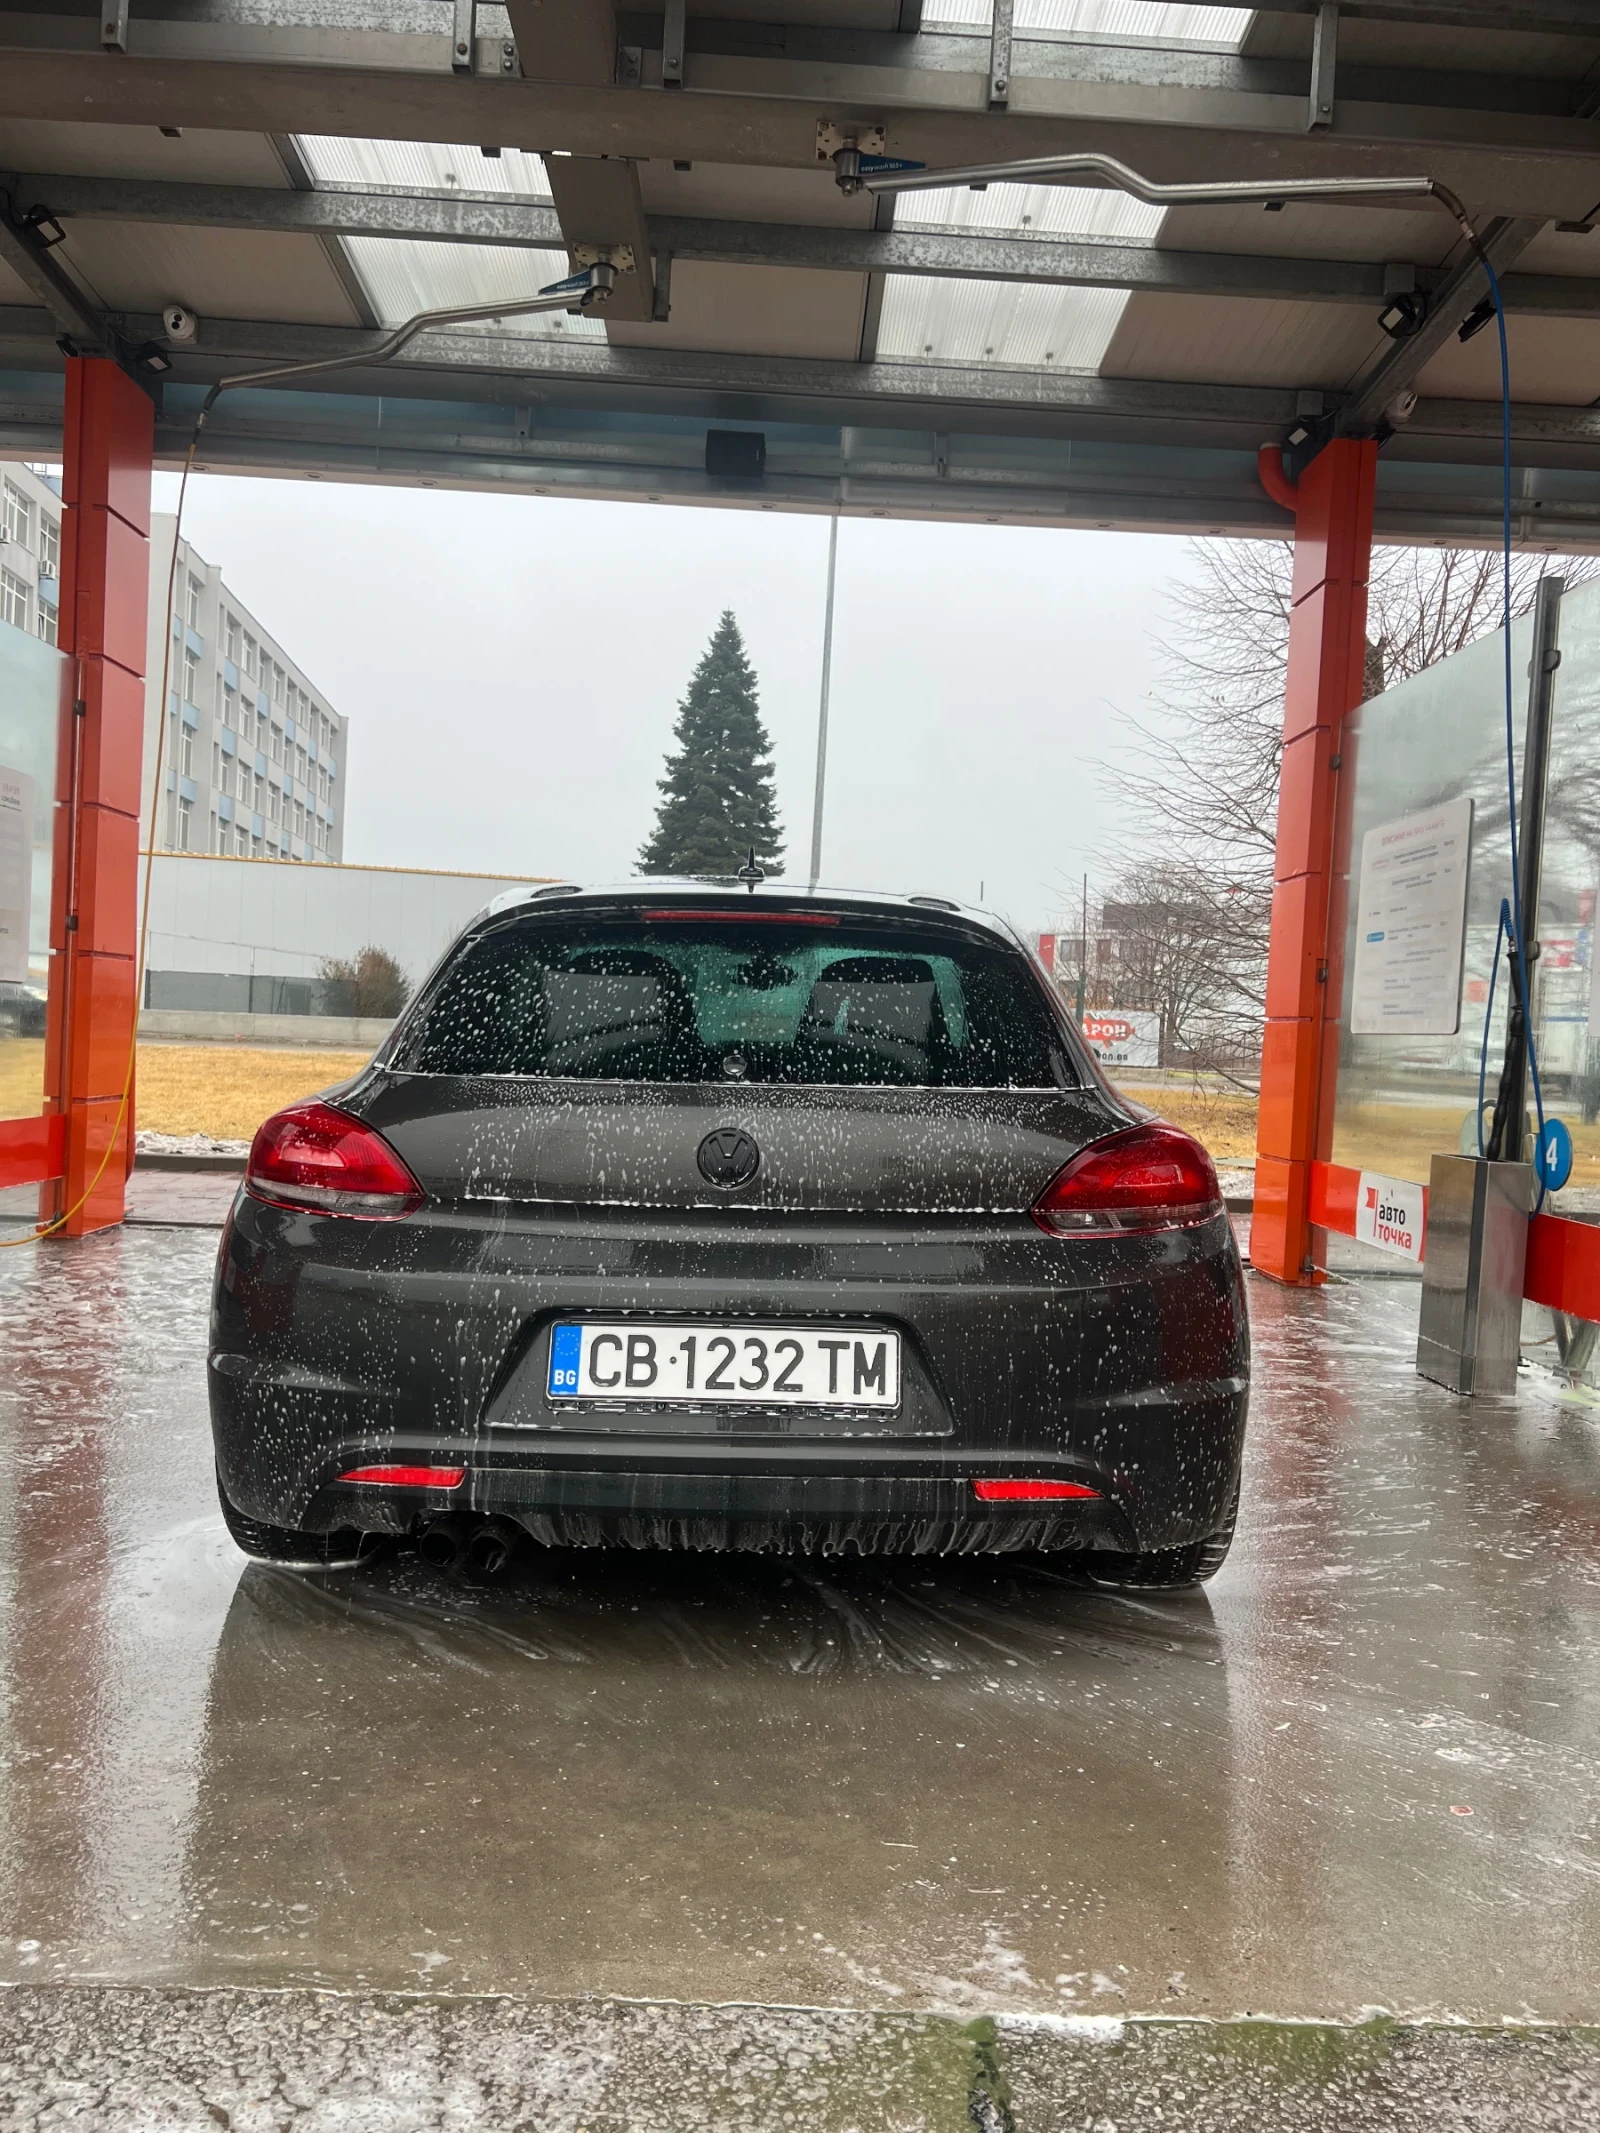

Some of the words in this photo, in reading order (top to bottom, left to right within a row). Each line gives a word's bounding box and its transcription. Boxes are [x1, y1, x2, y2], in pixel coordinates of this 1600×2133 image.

[1546, 1137, 1558, 1172] 4
[1379, 1204, 1406, 1225] авто
[1378, 1224, 1412, 1250] точка
[680, 1335, 804, 1392] 1232
[554, 1369, 577, 1386] BG
